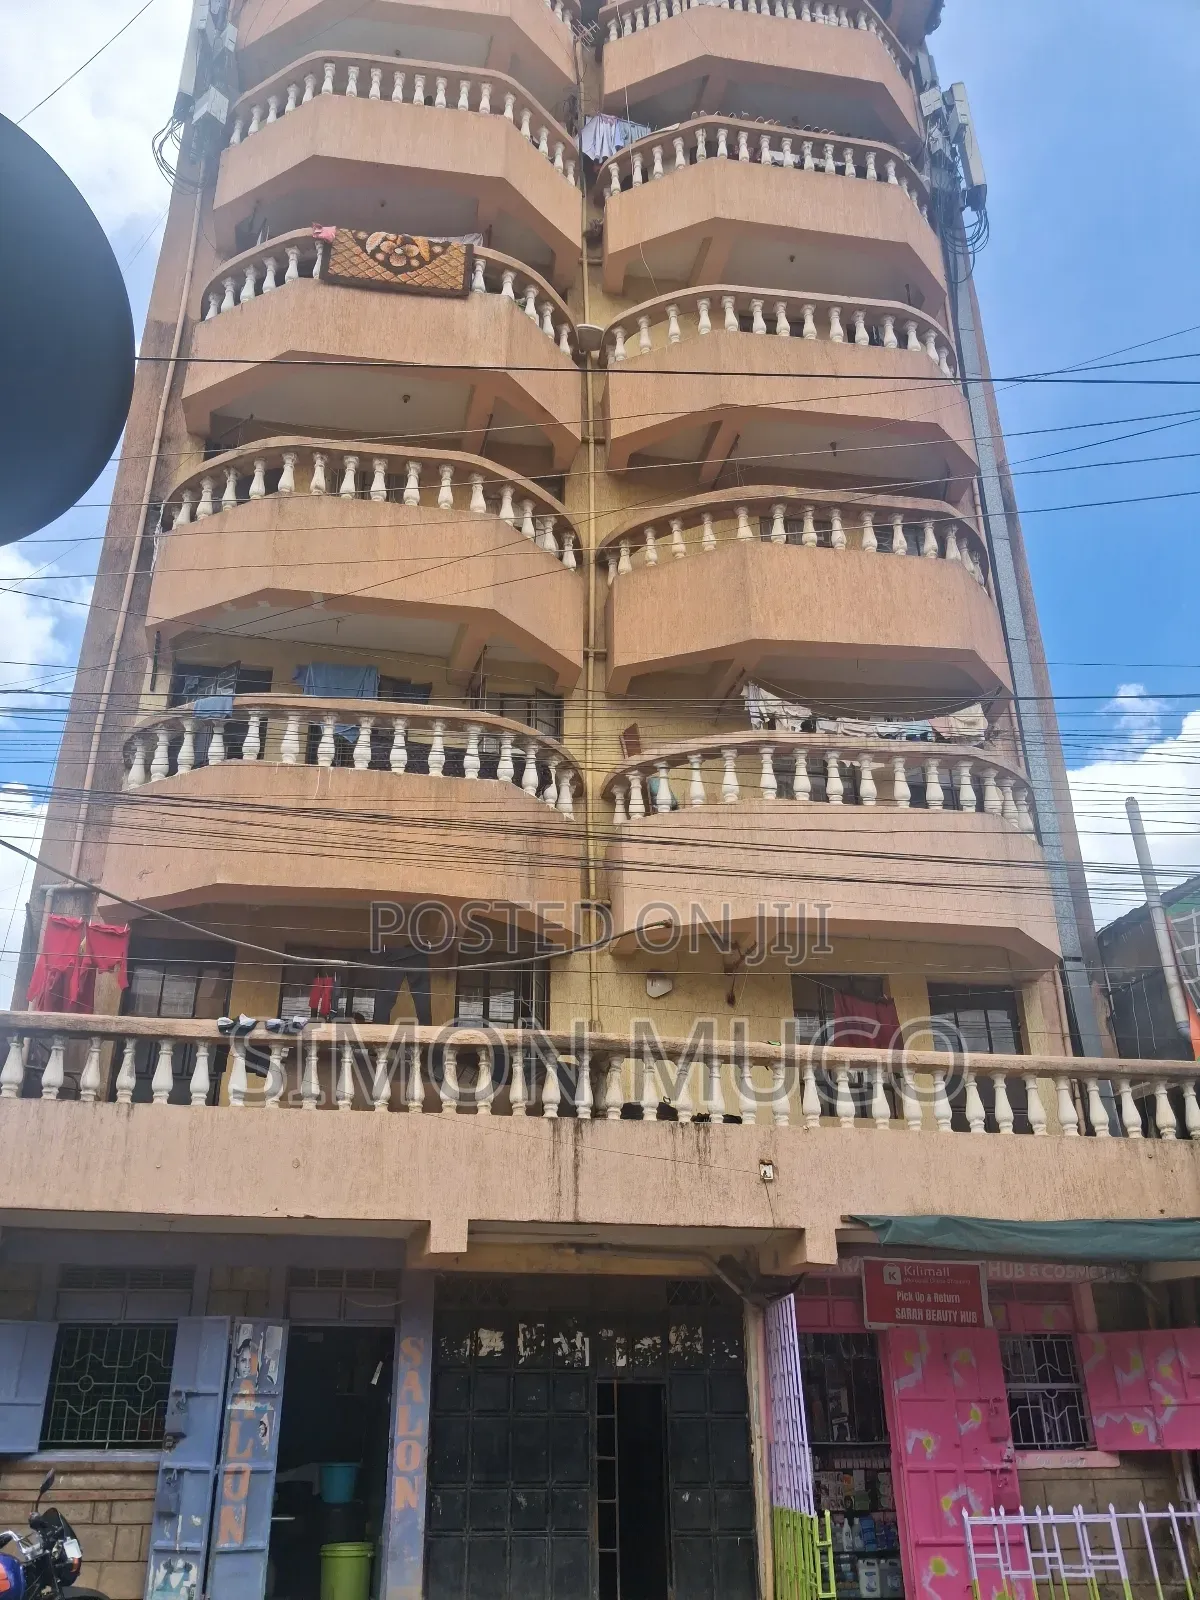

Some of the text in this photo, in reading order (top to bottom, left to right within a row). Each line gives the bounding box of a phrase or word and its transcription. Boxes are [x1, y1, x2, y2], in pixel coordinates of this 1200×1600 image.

[904, 1265, 950, 1277] Kilimall
[988, 1261, 1026, 1279] HUB
[896, 1290, 914, 1302] Pick
[915, 1291, 925, 1303] Up
[934, 1292, 960, 1303] Return
[895, 1307, 978, 1324] SARAH BEAUTY HUB
[394, 1335, 426, 1511] SALON
